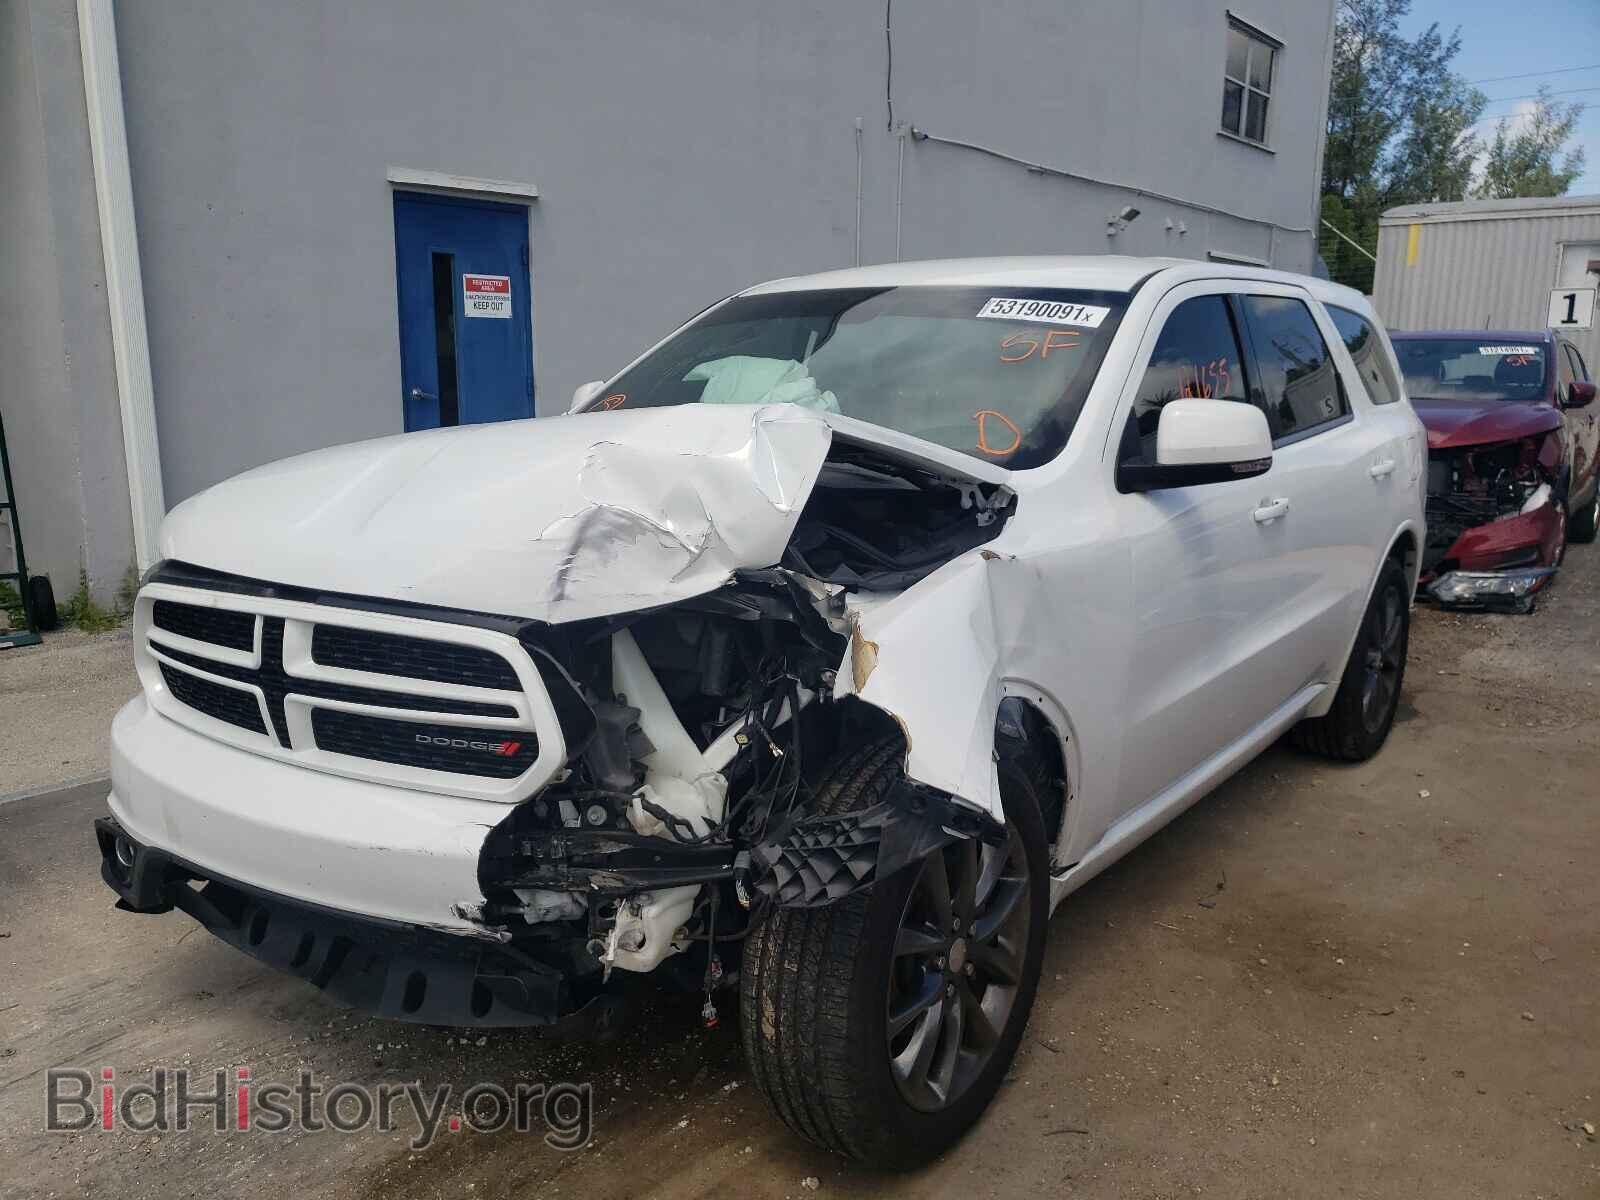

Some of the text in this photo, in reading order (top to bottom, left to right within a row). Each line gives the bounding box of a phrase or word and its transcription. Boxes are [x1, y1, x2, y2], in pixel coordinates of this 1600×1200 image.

[472, 279, 503, 287] RESTRICTED
[473, 300, 504, 311] KEEP OUT
[1561, 293, 1578, 324] 1
[1000, 329, 1081, 362] SF
[974, 410, 1021, 455] D
[415, 734, 506, 752] DODGE
